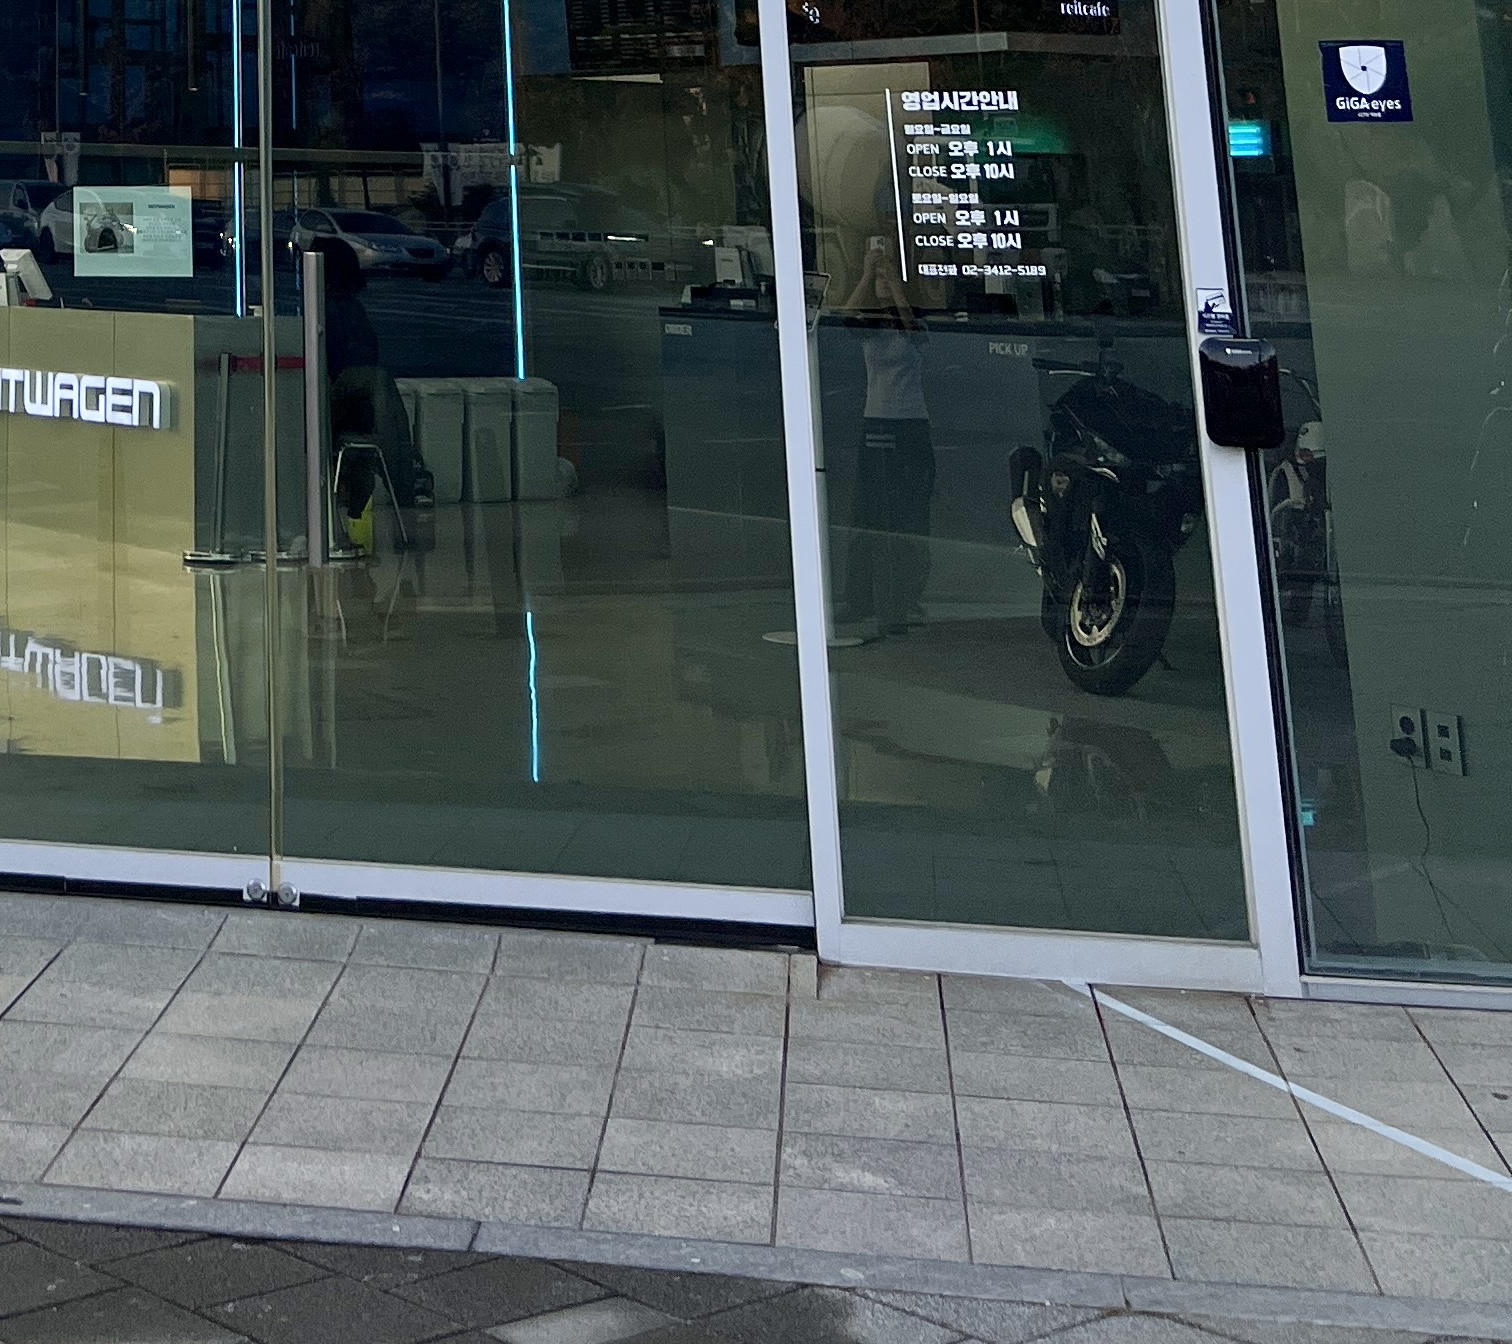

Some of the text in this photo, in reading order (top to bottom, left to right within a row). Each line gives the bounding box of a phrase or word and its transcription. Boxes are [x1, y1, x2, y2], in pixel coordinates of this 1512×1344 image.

[901, 90, 1019, 111] 영업시간안내
[906, 143, 940, 155] OPEN
[948, 140, 979, 157] 오후
[908, 162, 1015, 179] CLOSE 오후 10시
[913, 212, 947, 224] OPEN
[955, 210, 986, 226] 오후
[915, 232, 1022, 249] CLOSE 오후 10시
[988, 341, 1029, 356] PICK UP
